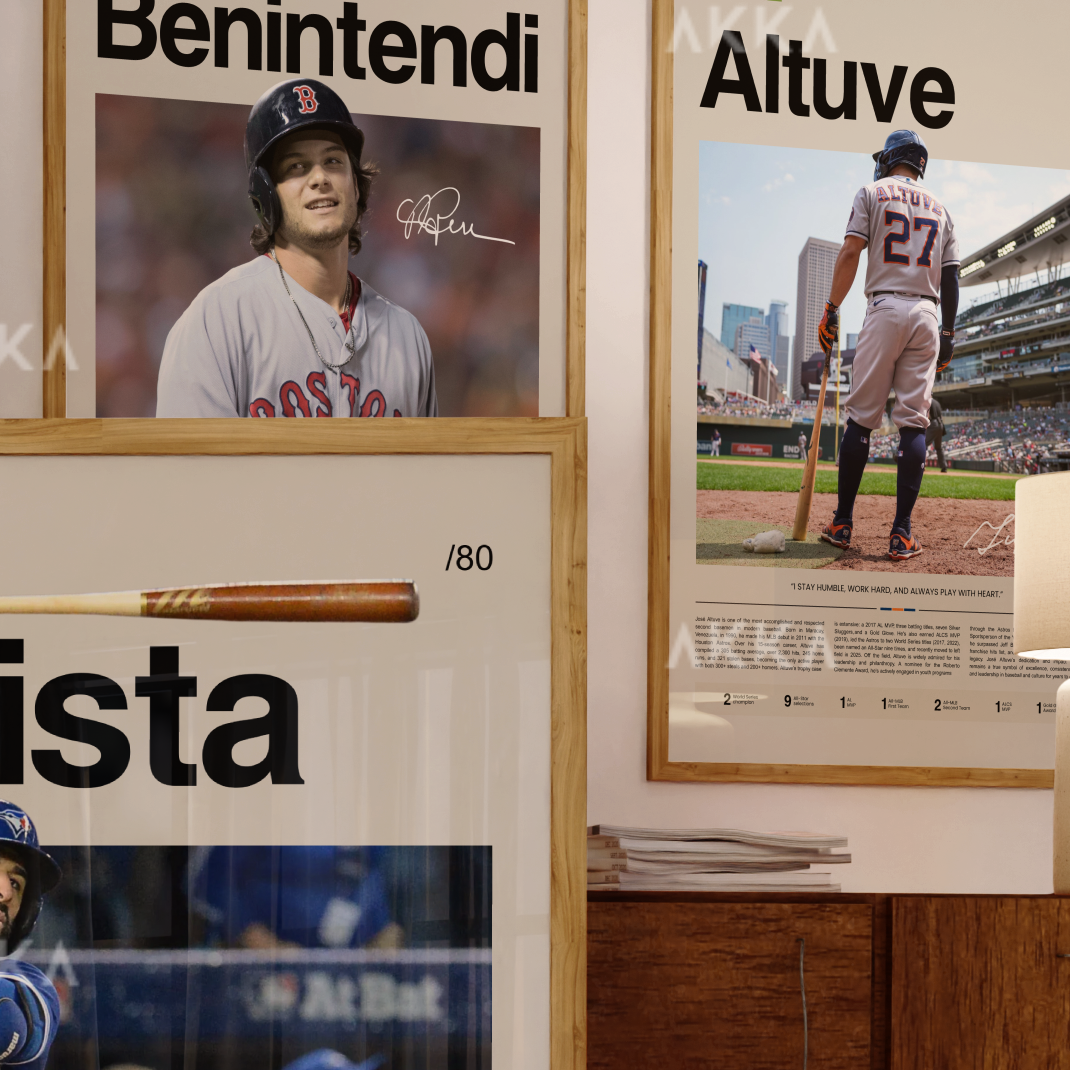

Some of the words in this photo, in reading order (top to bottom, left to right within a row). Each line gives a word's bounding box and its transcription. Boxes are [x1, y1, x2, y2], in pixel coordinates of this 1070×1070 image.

[97, 0, 539, 94] Benintendi
[700, 29, 956, 130] Altuve
[876, 185, 943, 217] ALTUVE
[883, 209, 940, 269] 27
[446, 545, 492, 570] /80
[798, 583, 815, 591] STAY
[817, 584, 846, 593] HUMBLE,
[848, 585, 869, 593] WORK
[871, 586, 892, 595] HARD,
[894, 587, 909, 595] AND
[910, 587, 938, 596] ALWAYS
[940, 589, 957, 597] PLAY
[723, 693, 731, 706] 2
[784, 695, 792, 707] 9
[840, 696, 846, 708] 1
[881, 698, 887, 710] 1
[934, 699, 942, 712] 2
[995, 701, 1001, 713] 1
[1036, 702, 1042, 714] 1
